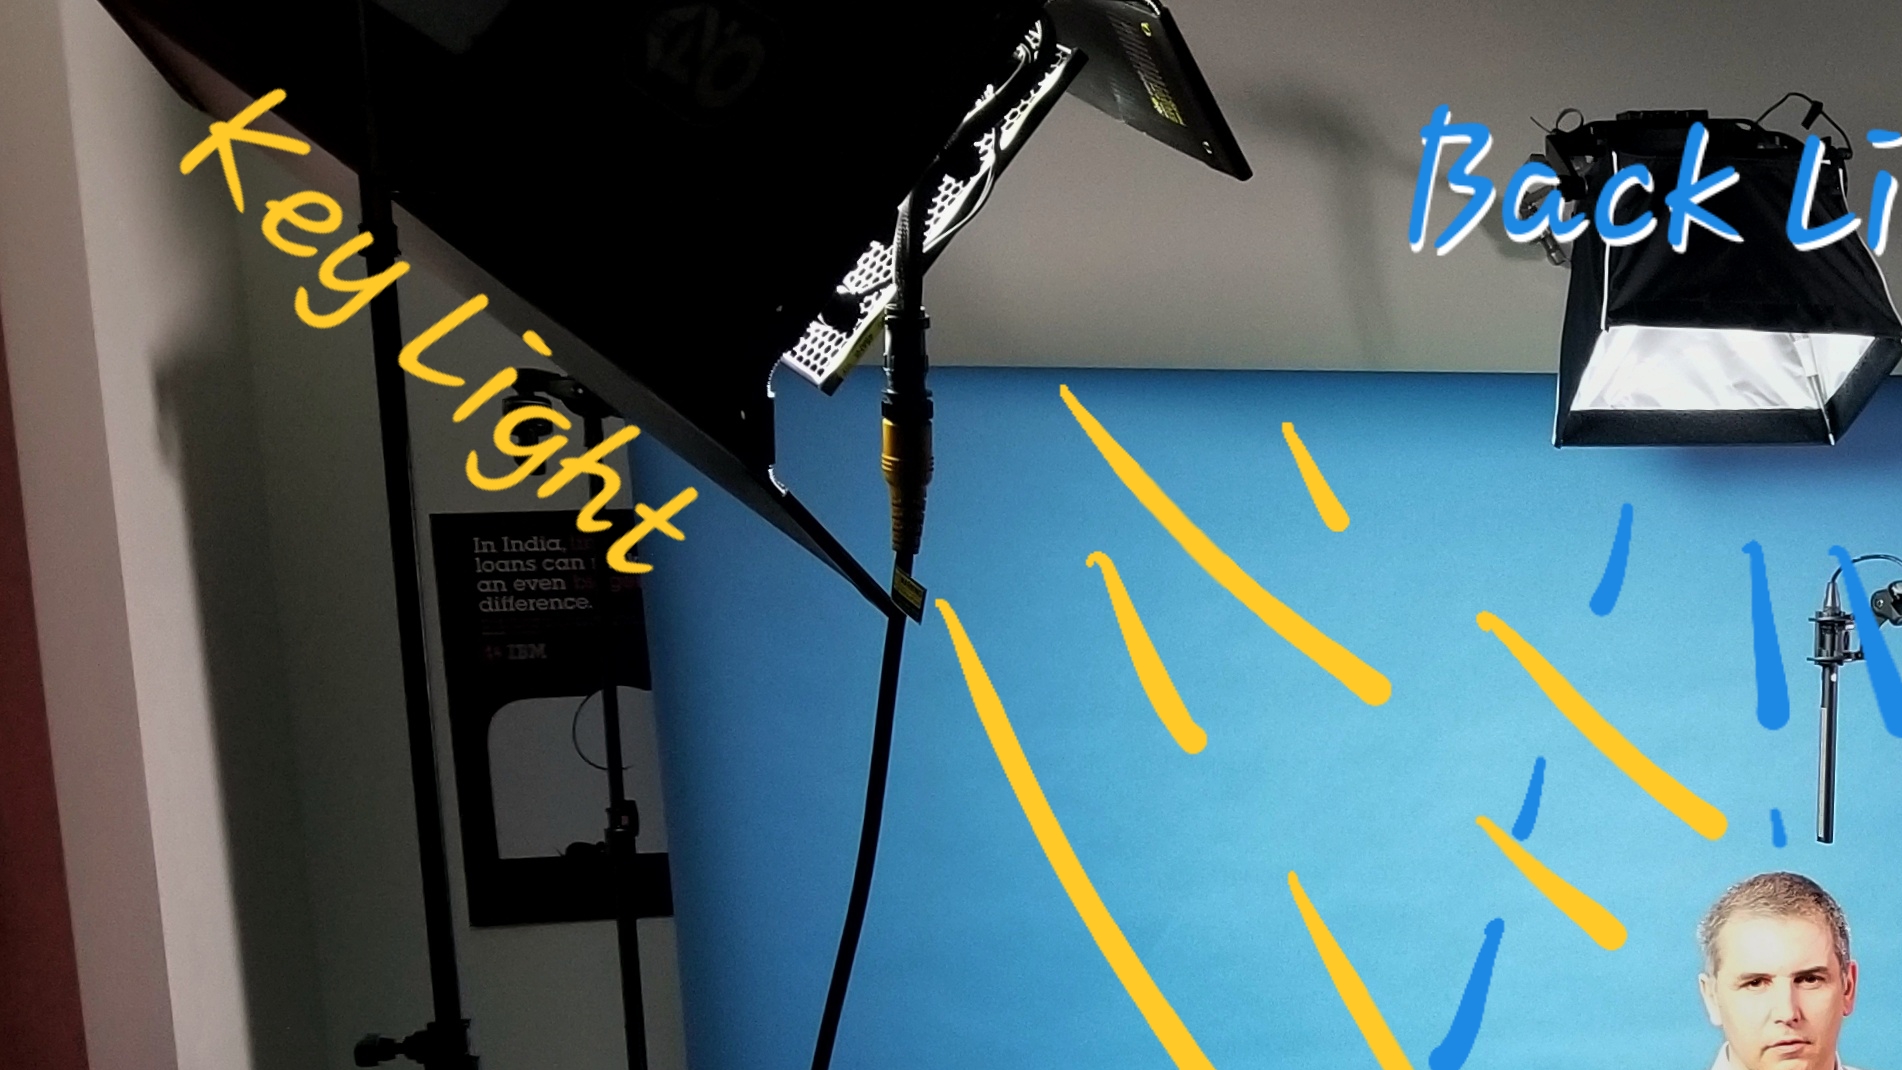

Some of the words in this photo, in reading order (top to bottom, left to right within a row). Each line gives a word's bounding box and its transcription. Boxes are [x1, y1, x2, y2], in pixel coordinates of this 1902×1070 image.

[473, 536, 498, 553] In
[501, 536, 568, 554] India,
[475, 557, 538, 573] loans
[541, 557, 586, 572] can
[476, 578, 508, 593] an
[512, 577, 567, 592] even
[478, 595, 593, 613] difference.
[507, 643, 548, 660] IBM
